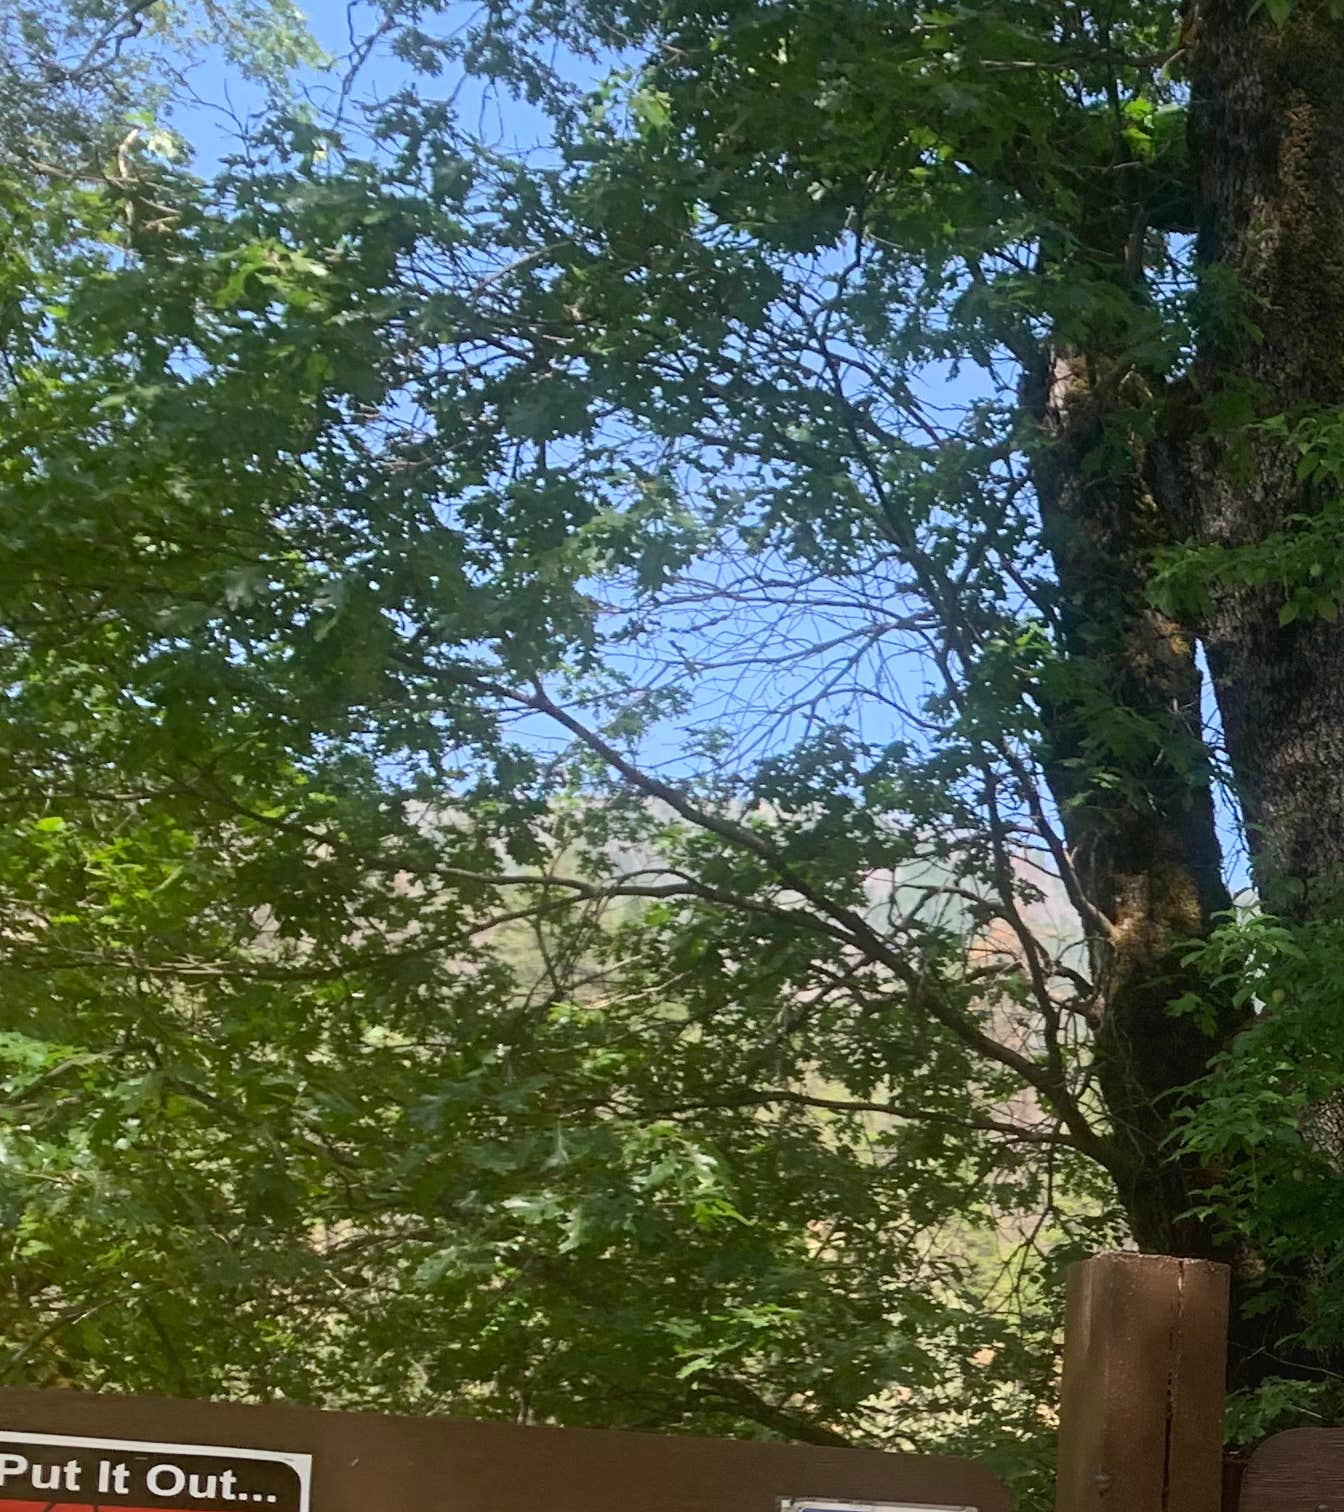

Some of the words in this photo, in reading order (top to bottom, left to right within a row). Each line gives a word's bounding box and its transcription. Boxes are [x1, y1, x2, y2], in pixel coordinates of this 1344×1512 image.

[0, 1454, 81, 1491] Put
[98, 1460, 130, 1494] It
[146, 1464, 276, 1503] Out...
